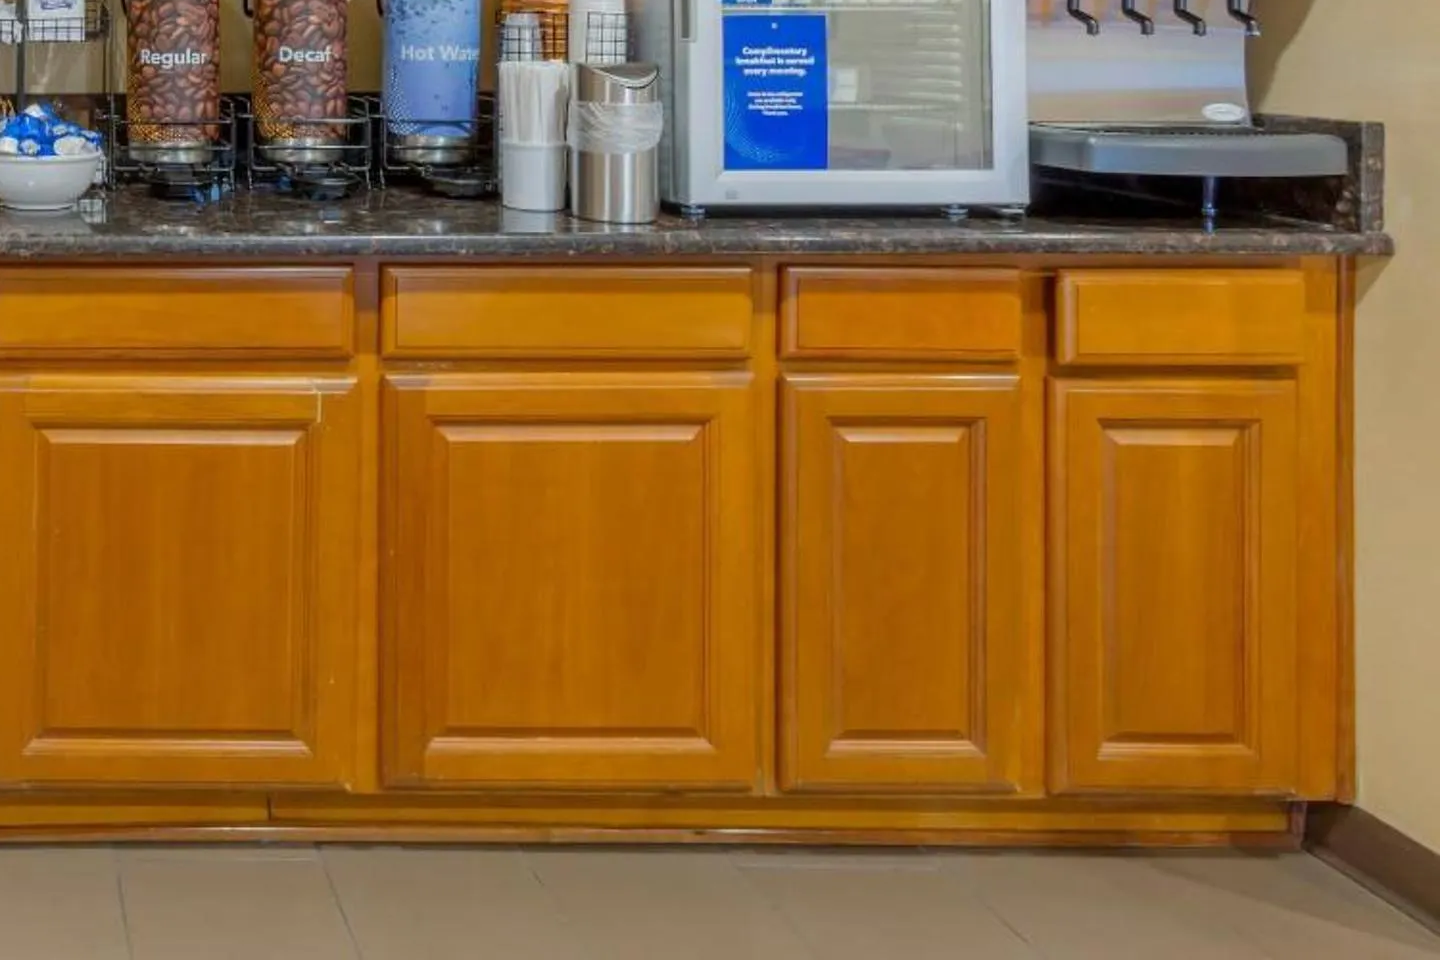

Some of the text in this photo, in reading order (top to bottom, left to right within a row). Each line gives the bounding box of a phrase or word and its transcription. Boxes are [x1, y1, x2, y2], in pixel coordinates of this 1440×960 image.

[140, 48, 208, 69] Regular
[279, 46, 333, 63] Decaf
[401, 44, 435, 61] Hot
